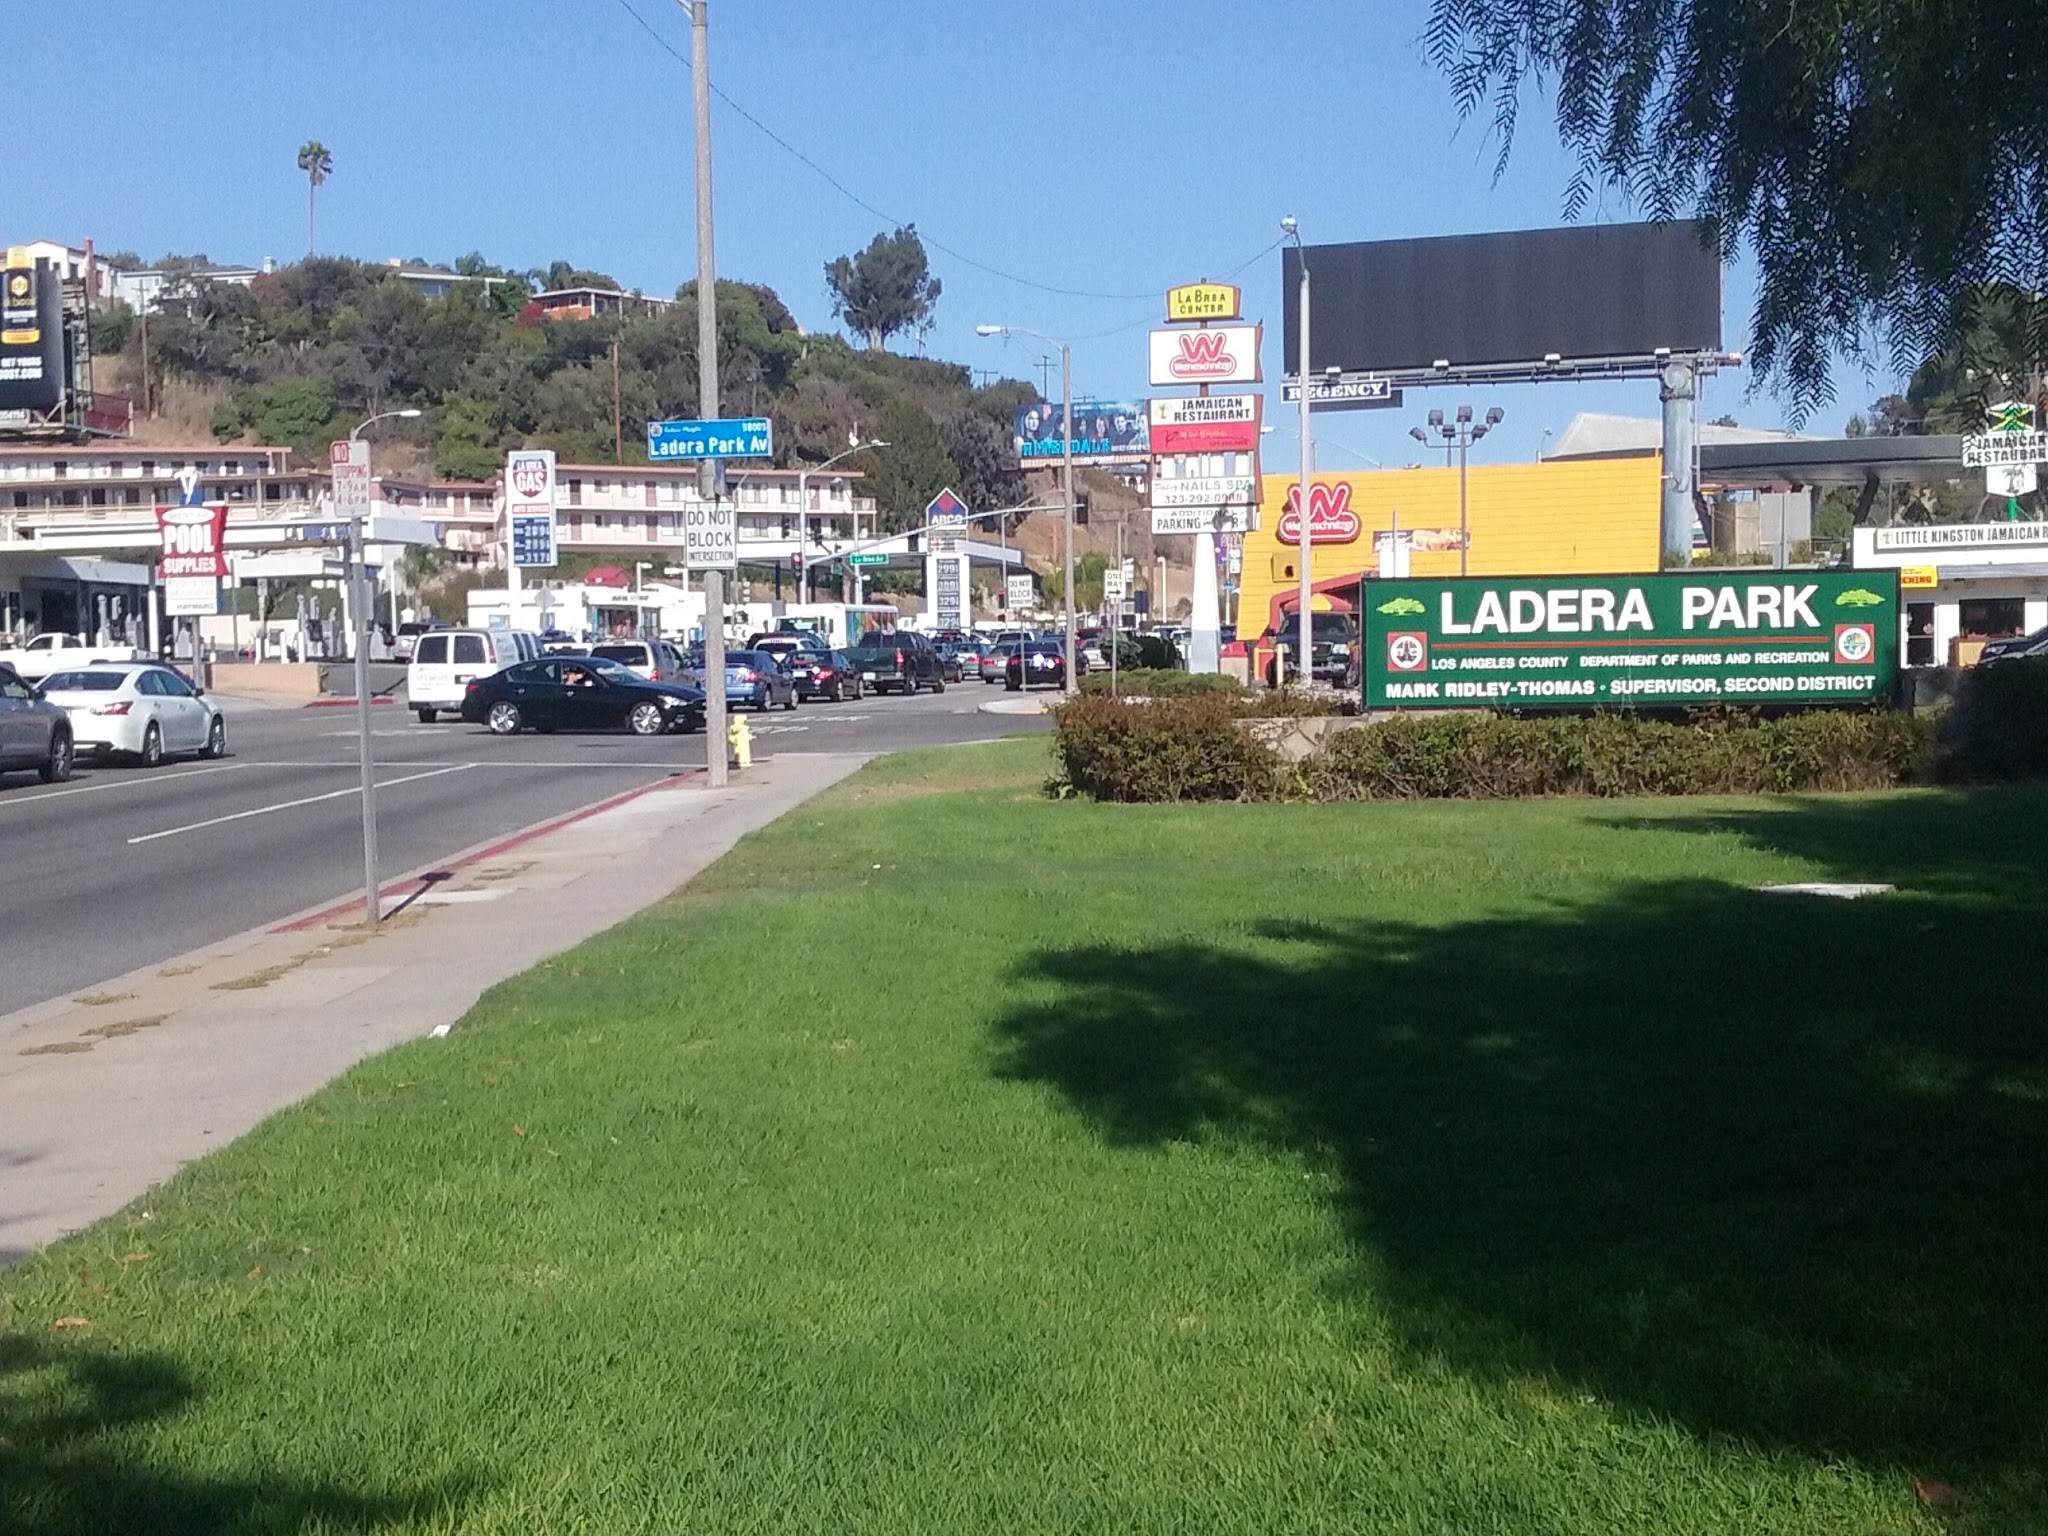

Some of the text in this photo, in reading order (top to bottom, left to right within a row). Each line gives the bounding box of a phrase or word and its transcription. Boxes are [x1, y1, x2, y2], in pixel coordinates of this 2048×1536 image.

[1180, 304, 1224, 314] CENTER
[1288, 383, 1384, 400] REGENCY
[1181, 397, 1243, 411] JAMAICAN
[1174, 408, 1251, 423] RESTAURANT
[334, 444, 348, 462] NO
[650, 435, 768, 456] Ladera Park Av
[516, 471, 544, 493] GAS
[1180, 480, 1221, 491] NAILS
[687, 510, 733, 526] DO NOT
[1157, 517, 1201, 530] PARKING
[163, 524, 215, 556] POOL
[688, 531, 733, 548] BLOCK
[1896, 530, 1928, 545] LITTLE
[1931, 528, 1985, 543] KINGSTON
[1987, 526, 2041, 541] JAMAICAN
[163, 556, 217, 574] SUPPLIES
[1441, 584, 1821, 635] LADERA PARK
[1431, 651, 1830, 670] LOS ANGELES COUNTY DEPARTMENT OF PARKS AND RECREATION
[1385, 675, 1876, 699] MARK RIDLEY-THOMAS SUPERVISOR, SECOND DISTRICT
